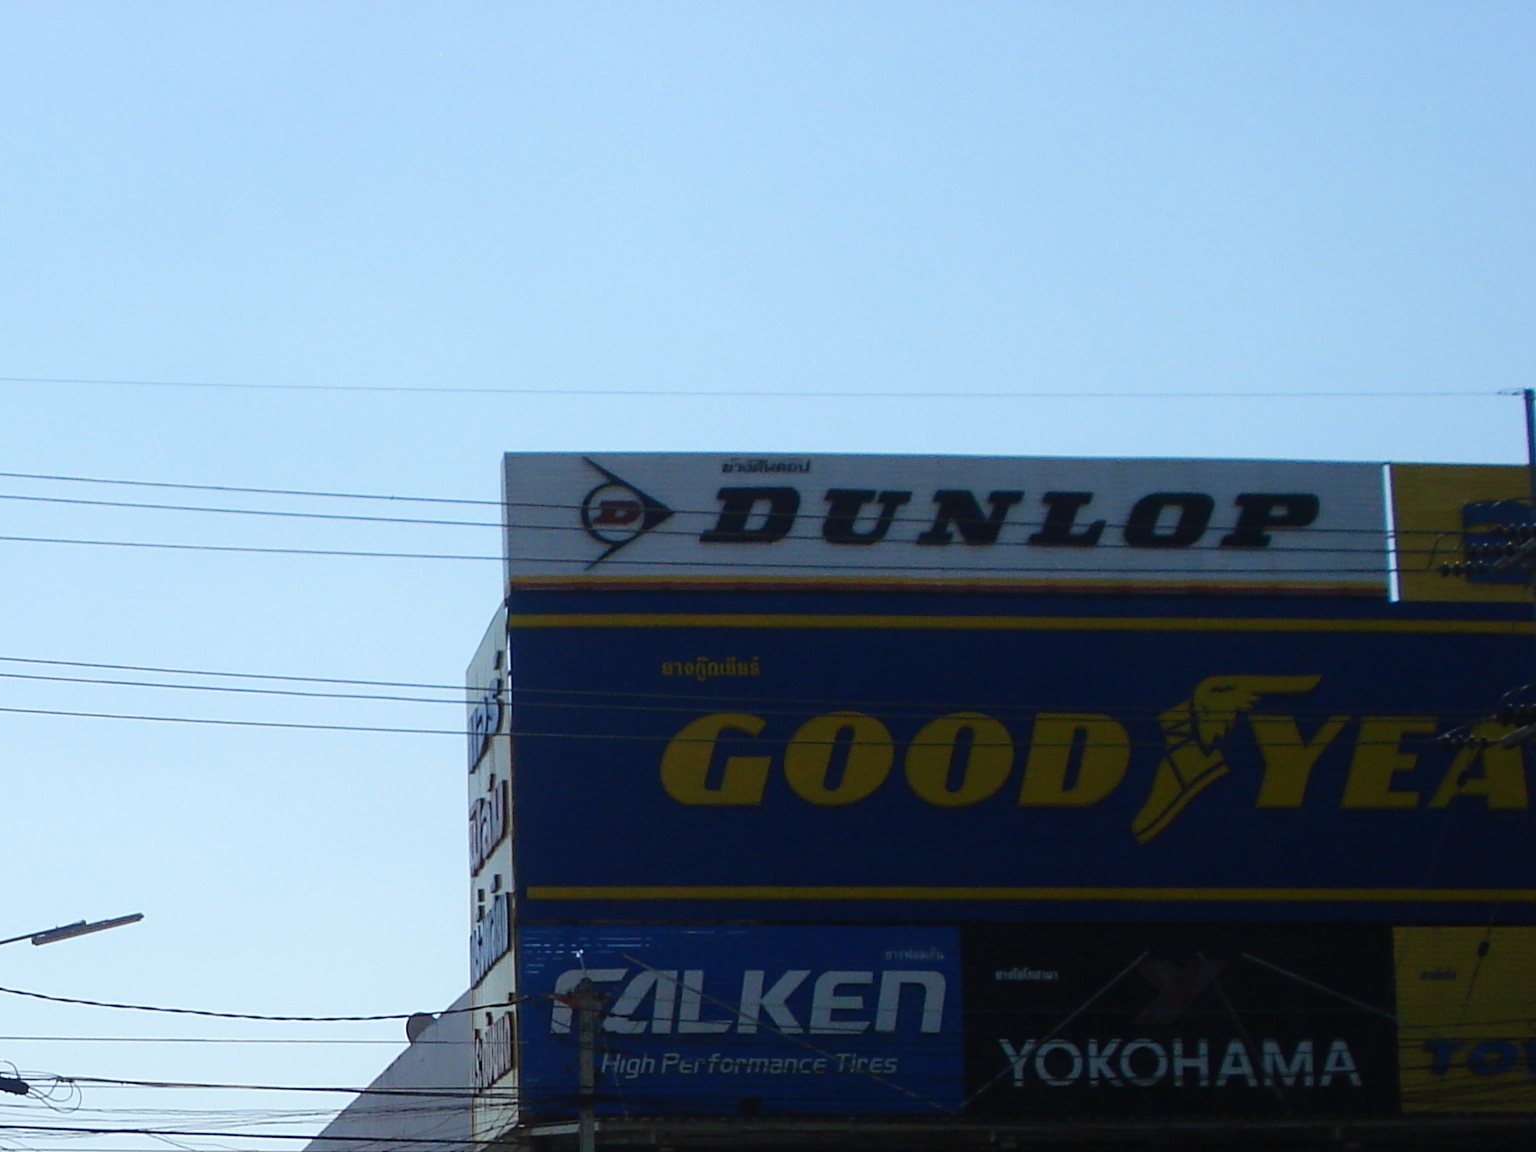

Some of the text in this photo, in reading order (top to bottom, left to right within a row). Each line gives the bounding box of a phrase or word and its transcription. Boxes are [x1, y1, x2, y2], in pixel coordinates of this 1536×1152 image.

[699, 486, 1321, 549] DUNLOP
[550, 968, 947, 1035] FALKEN
[601, 1053, 898, 1079] High Performance Tires
[998, 1037, 1363, 1088] YOKOHAMA
[1423, 1039, 1536, 1075] TO
